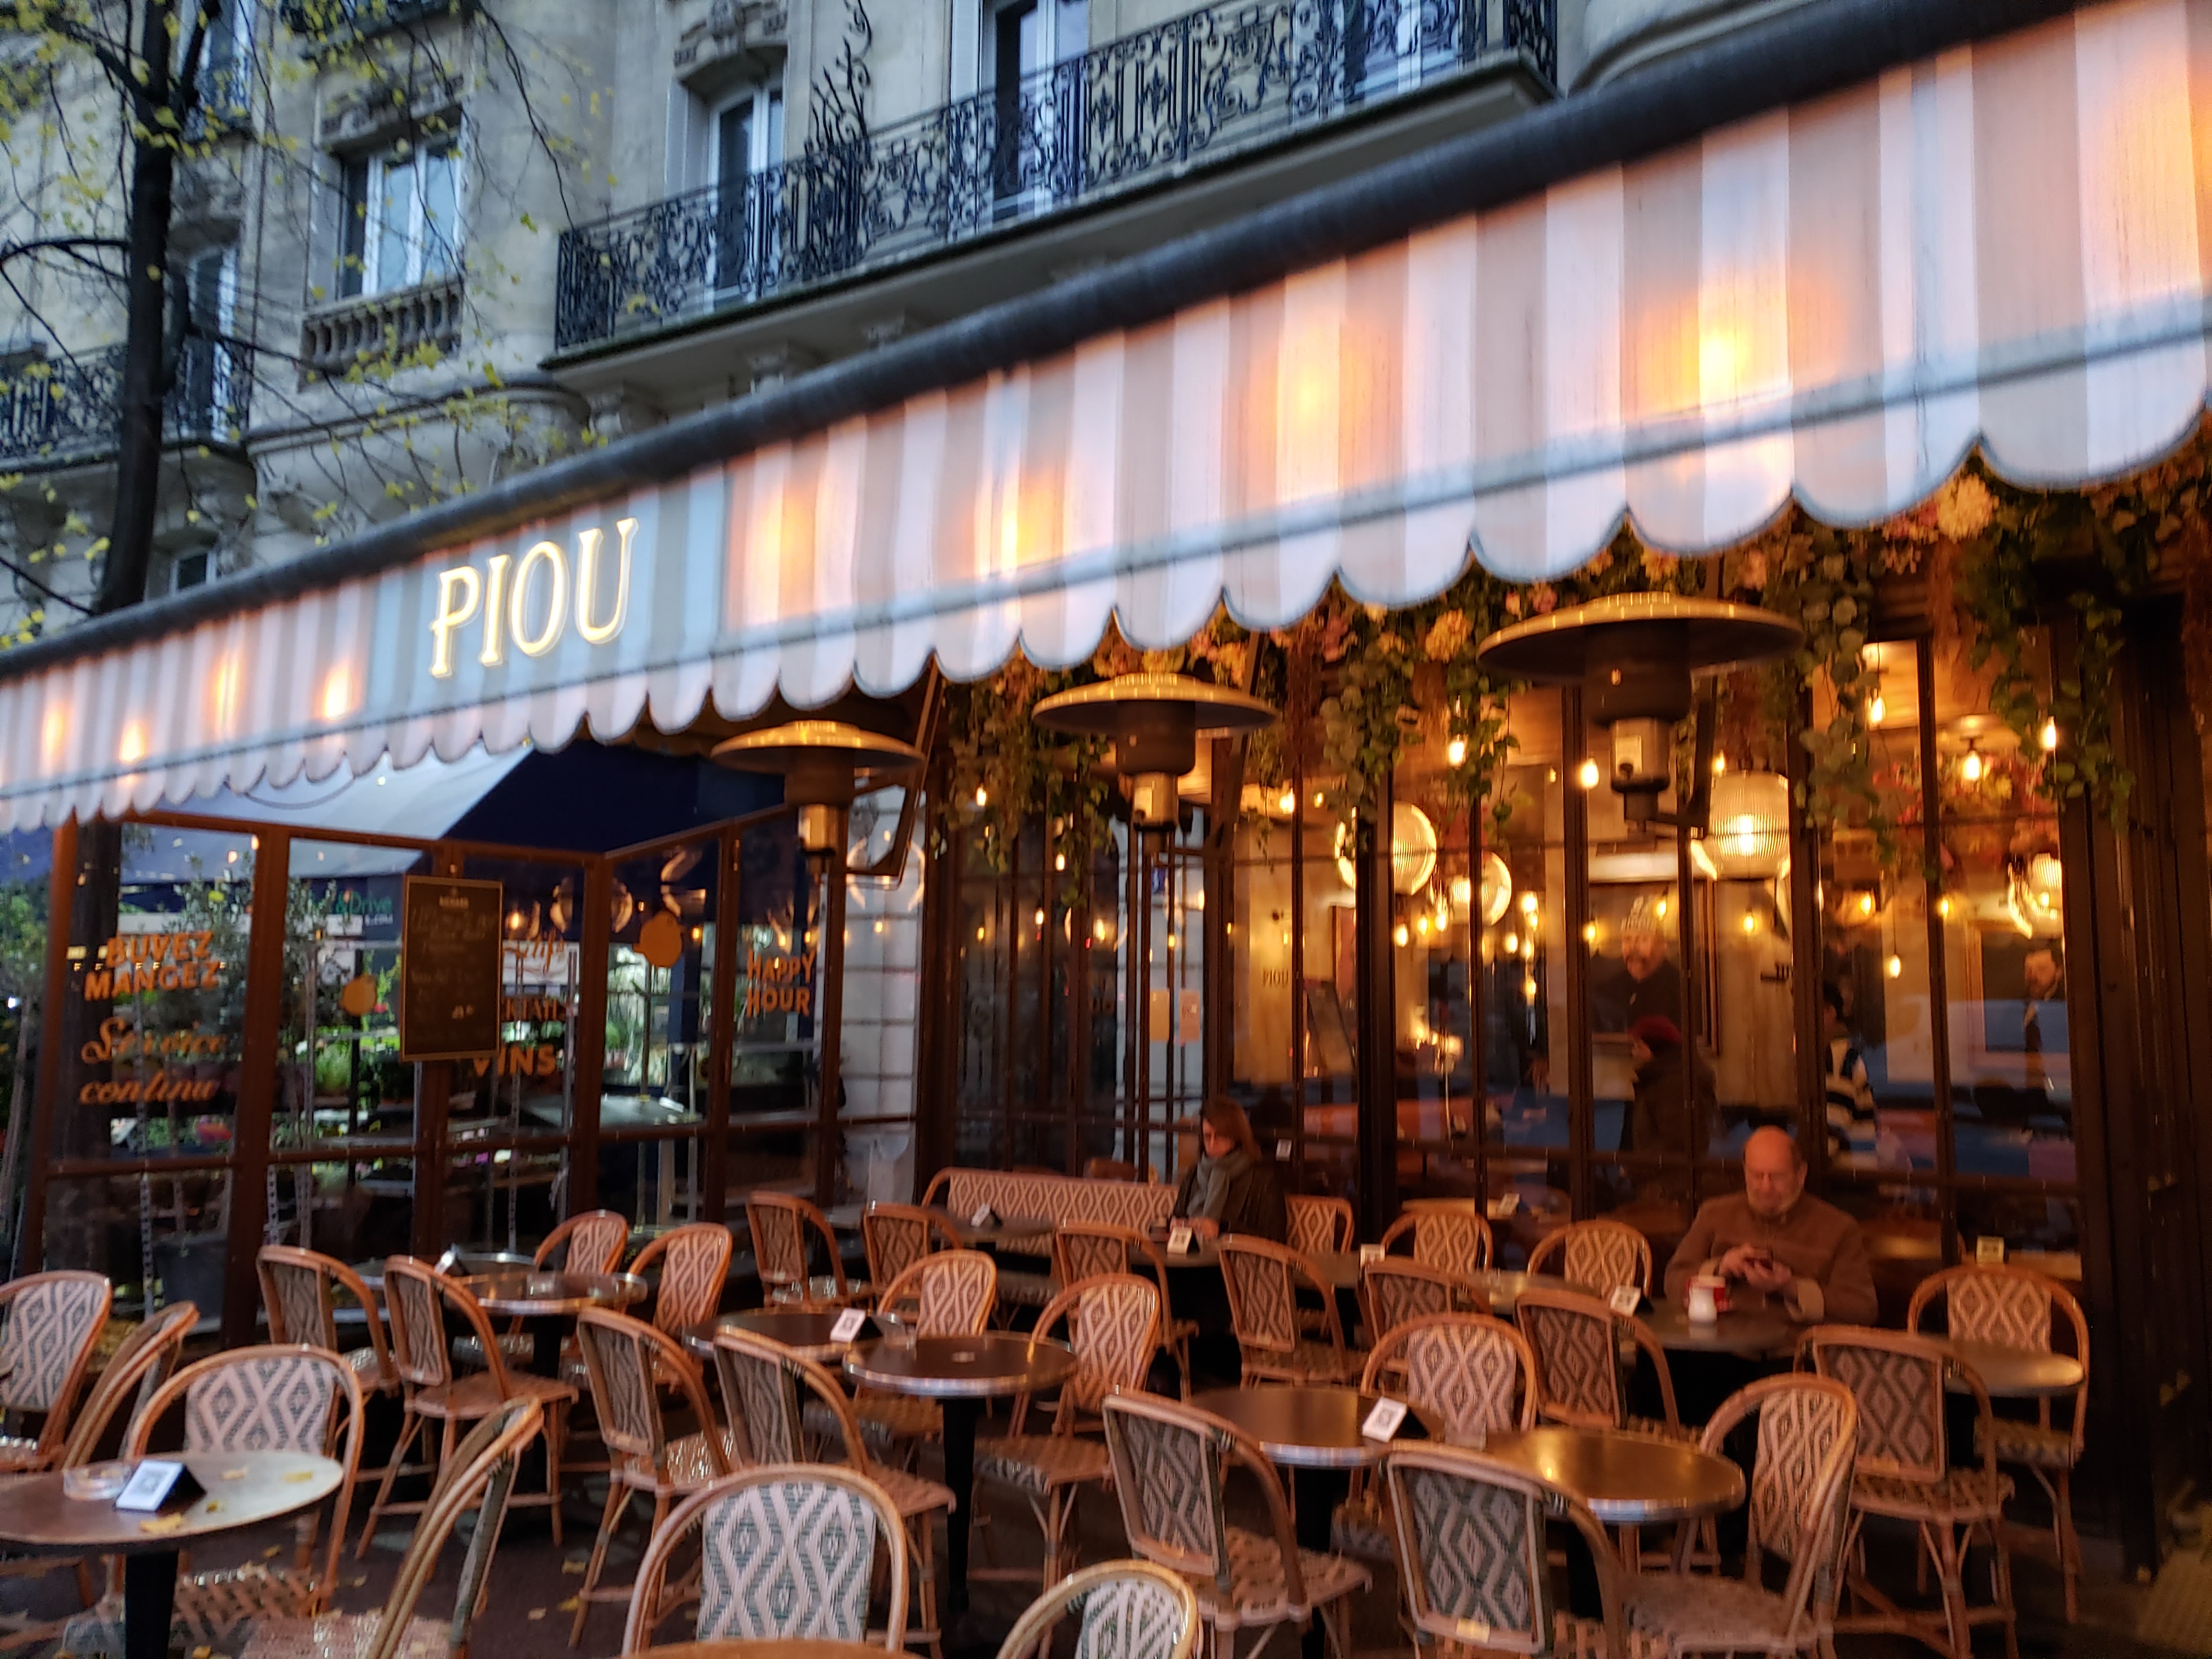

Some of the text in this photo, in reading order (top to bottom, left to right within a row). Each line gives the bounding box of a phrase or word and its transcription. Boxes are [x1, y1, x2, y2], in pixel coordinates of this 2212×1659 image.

[428, 517, 640, 679] PIOU
[105, 930, 214, 968] BUVEZ
[747, 949, 816, 984] HAPPY
[84, 961, 222, 1002] MANGEZ
[747, 986, 811, 1018] HOUR
[81, 1016, 228, 1064] Service
[473, 1043, 556, 1077] VINS
[80, 1068, 216, 1105] continu
